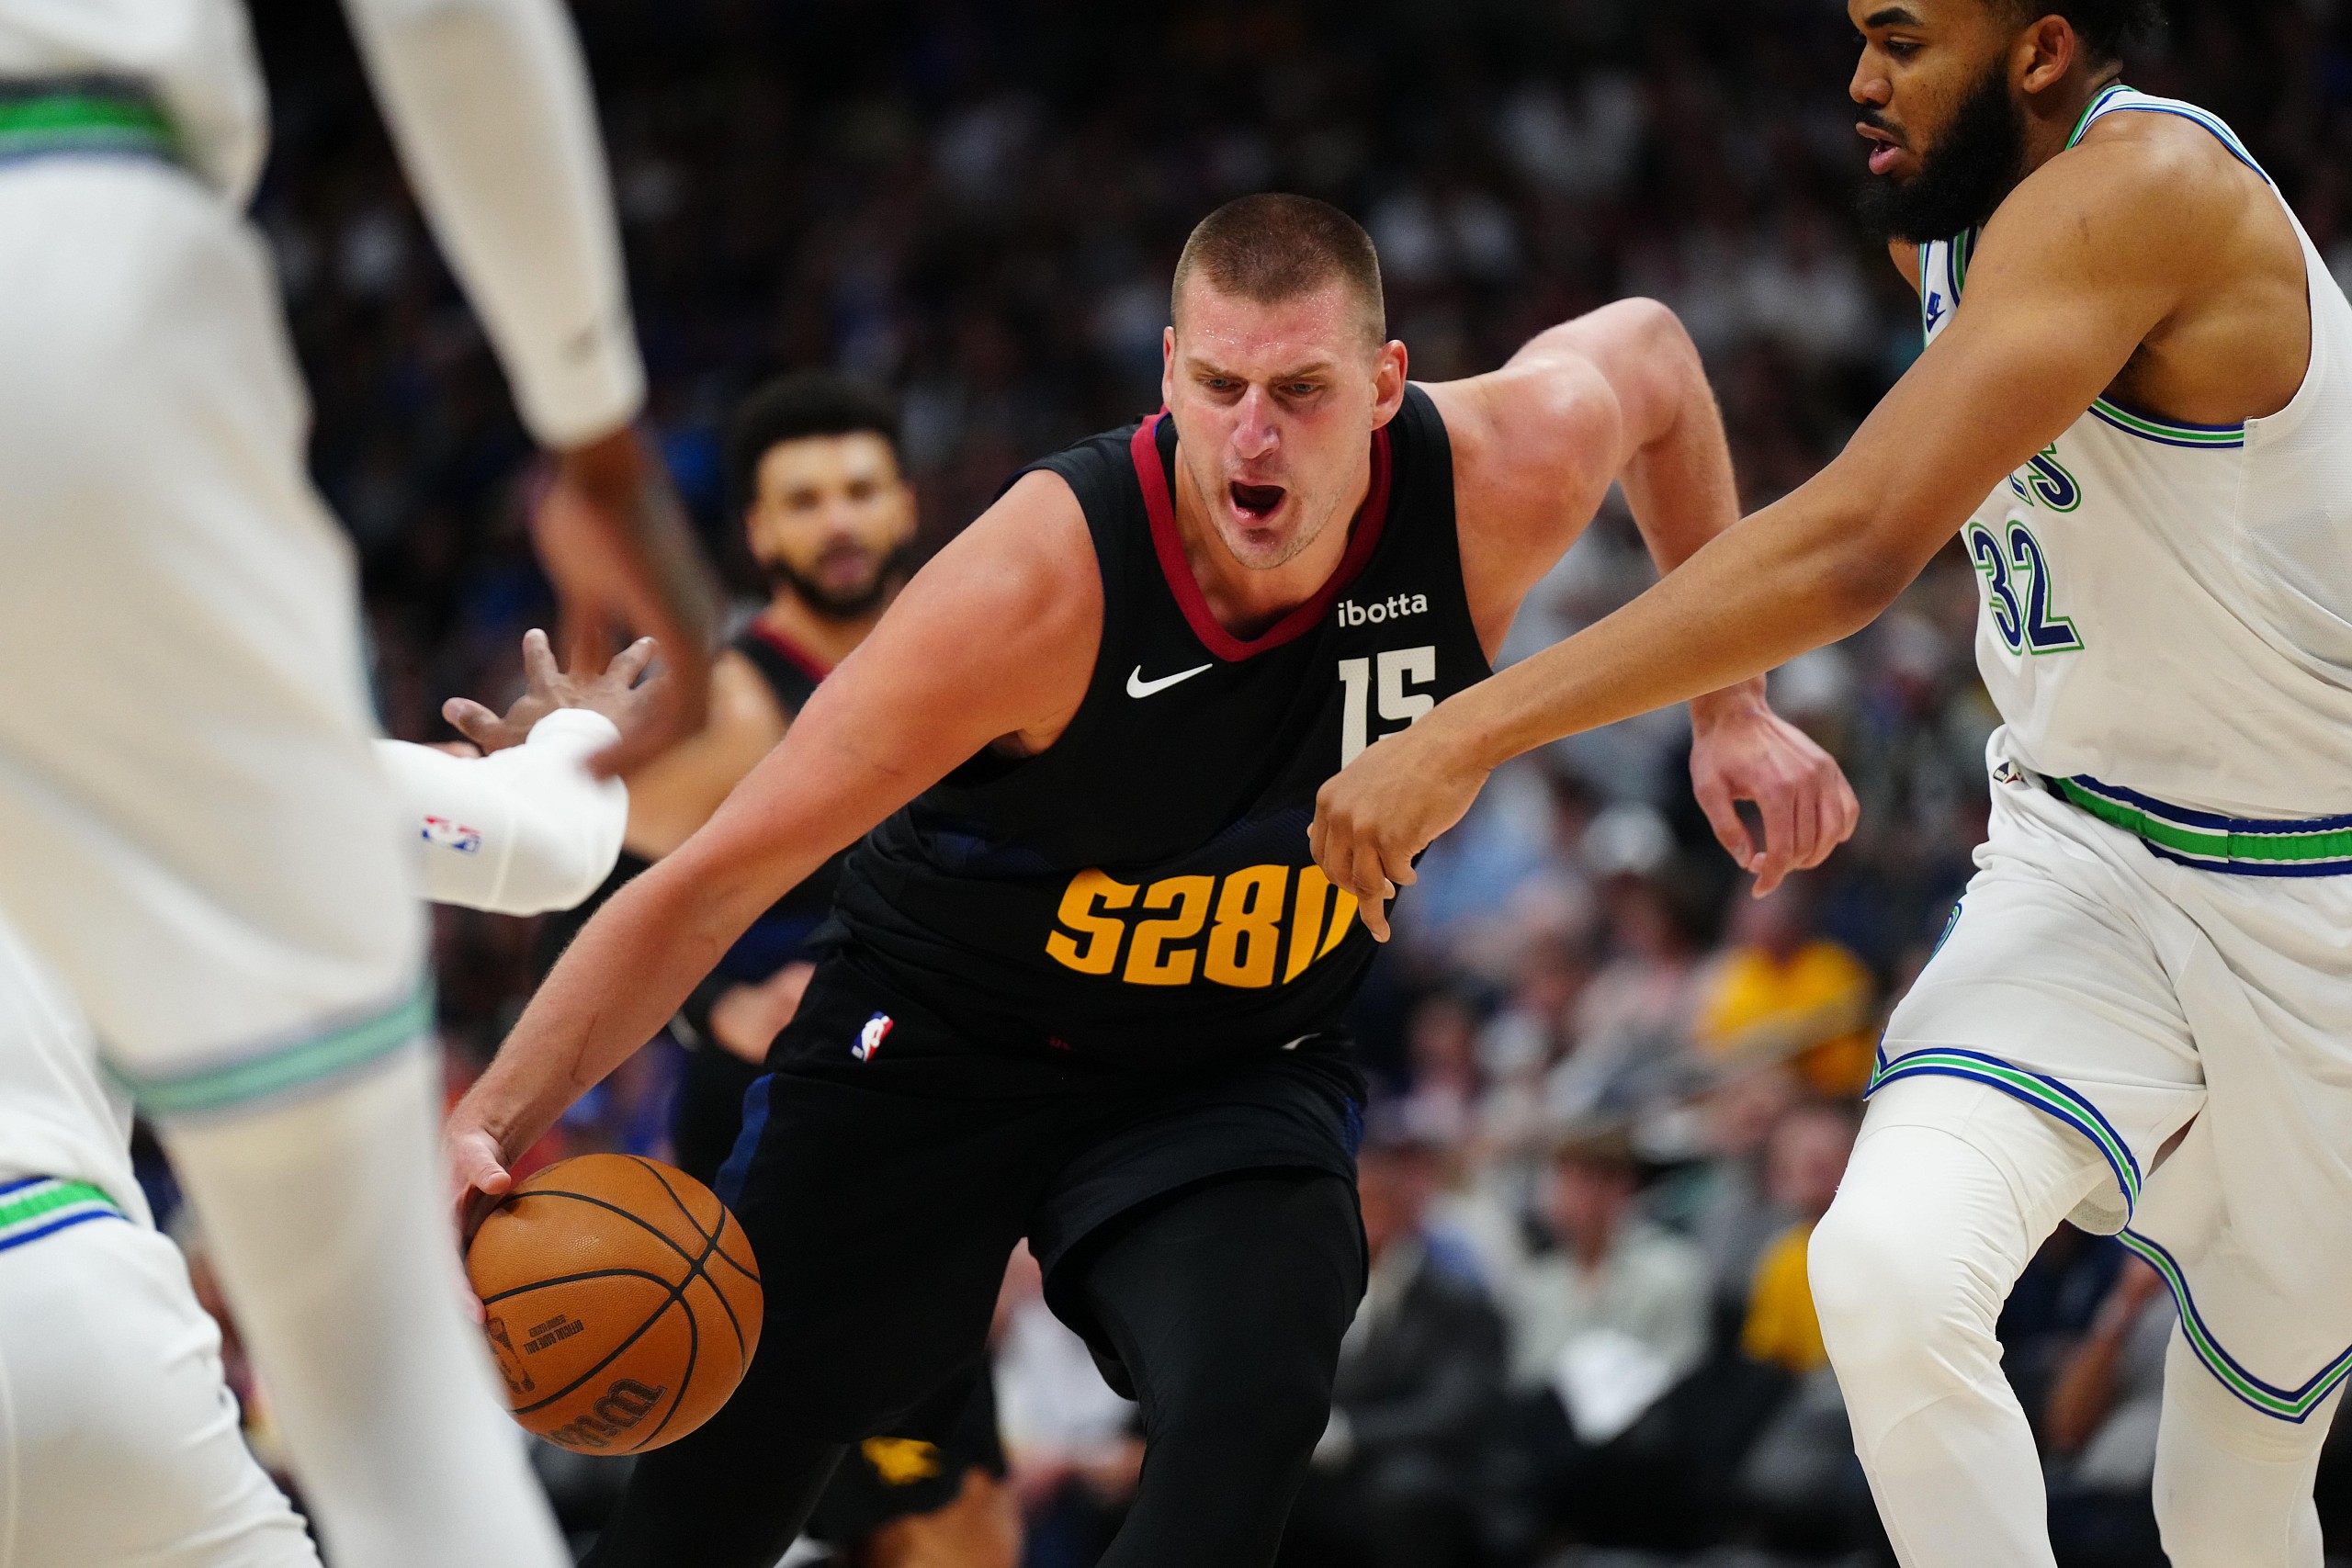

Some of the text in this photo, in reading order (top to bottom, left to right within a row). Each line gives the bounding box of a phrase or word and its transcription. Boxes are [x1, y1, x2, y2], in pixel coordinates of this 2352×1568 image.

[1338, 593, 1429, 627] ibotta
[1968, 520, 2085, 656] 32
[1339, 646, 1435, 770] 15
[554, 1319, 584, 1341] OFFICIAL
